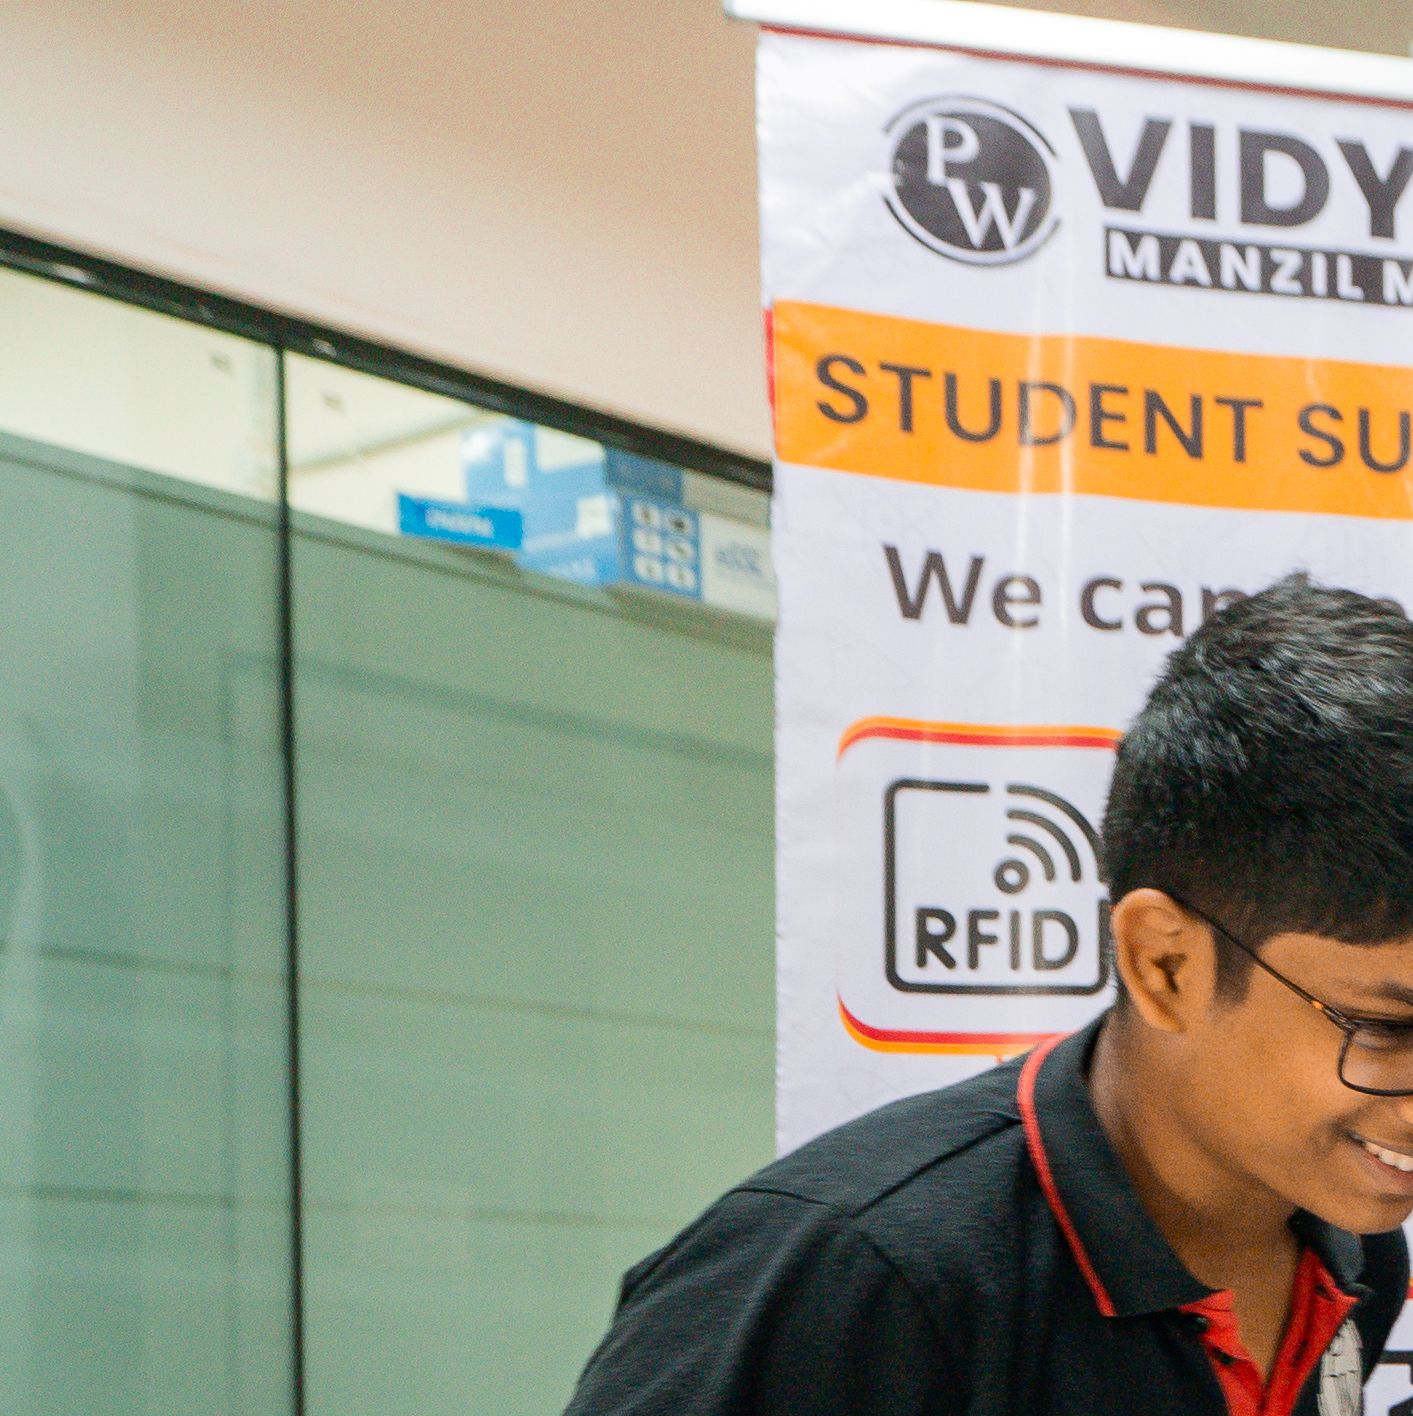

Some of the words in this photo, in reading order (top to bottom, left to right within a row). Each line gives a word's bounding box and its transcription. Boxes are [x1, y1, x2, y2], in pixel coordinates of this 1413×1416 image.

[1109, 230, 1364, 299] MANZIL
[816, 353, 1262, 462] STUDENT
[881, 543, 1042, 630] We
[916, 907, 1079, 970] RFID
